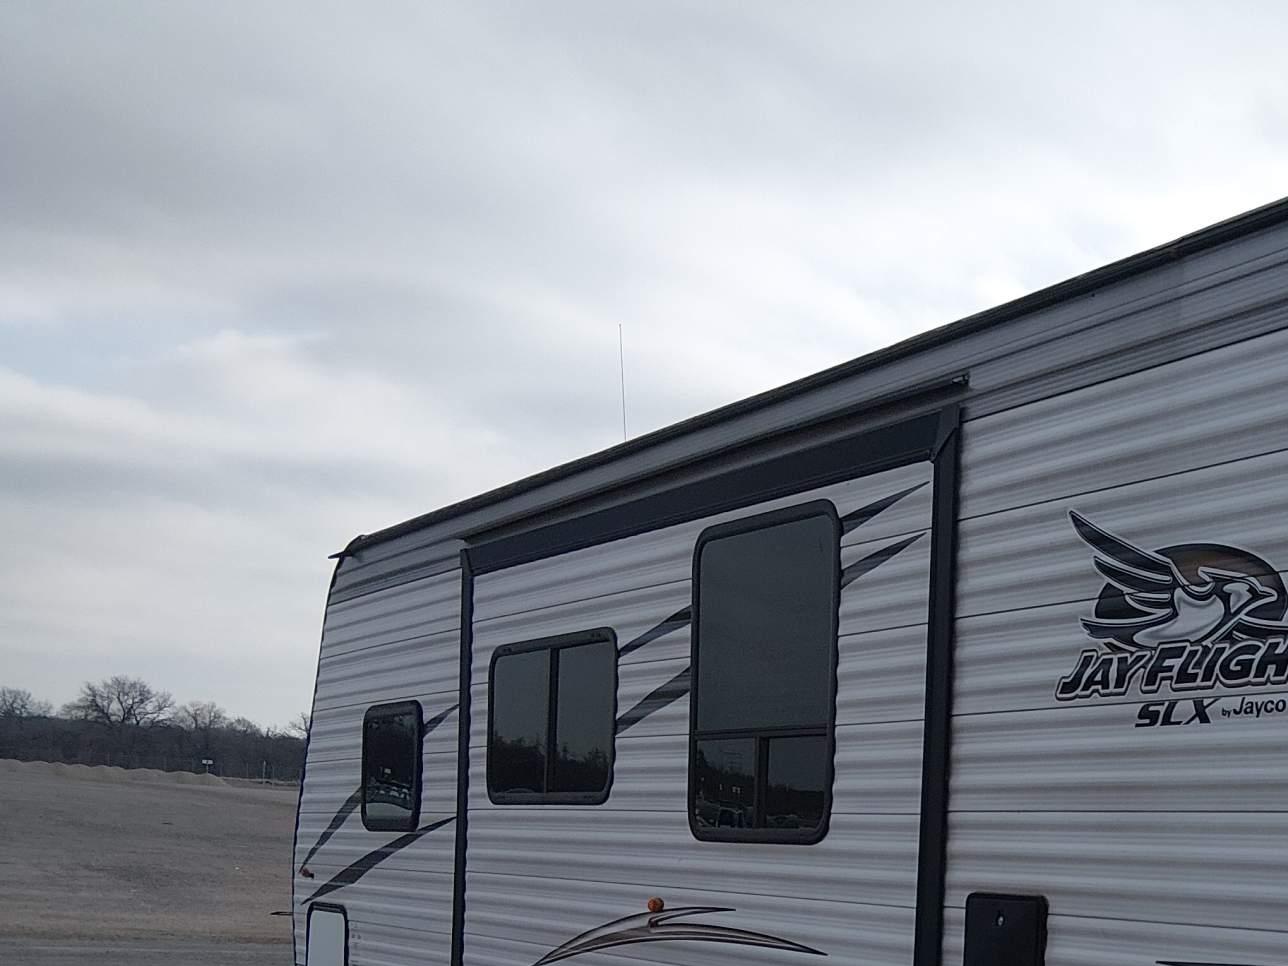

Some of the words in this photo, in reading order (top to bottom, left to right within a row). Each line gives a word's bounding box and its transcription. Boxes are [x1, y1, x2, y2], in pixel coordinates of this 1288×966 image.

[1056, 649, 1149, 699] JAY
[1134, 698, 1223, 728] SLX
[1221, 707, 1232, 718] by
[1233, 697, 1287, 718] Jayco
